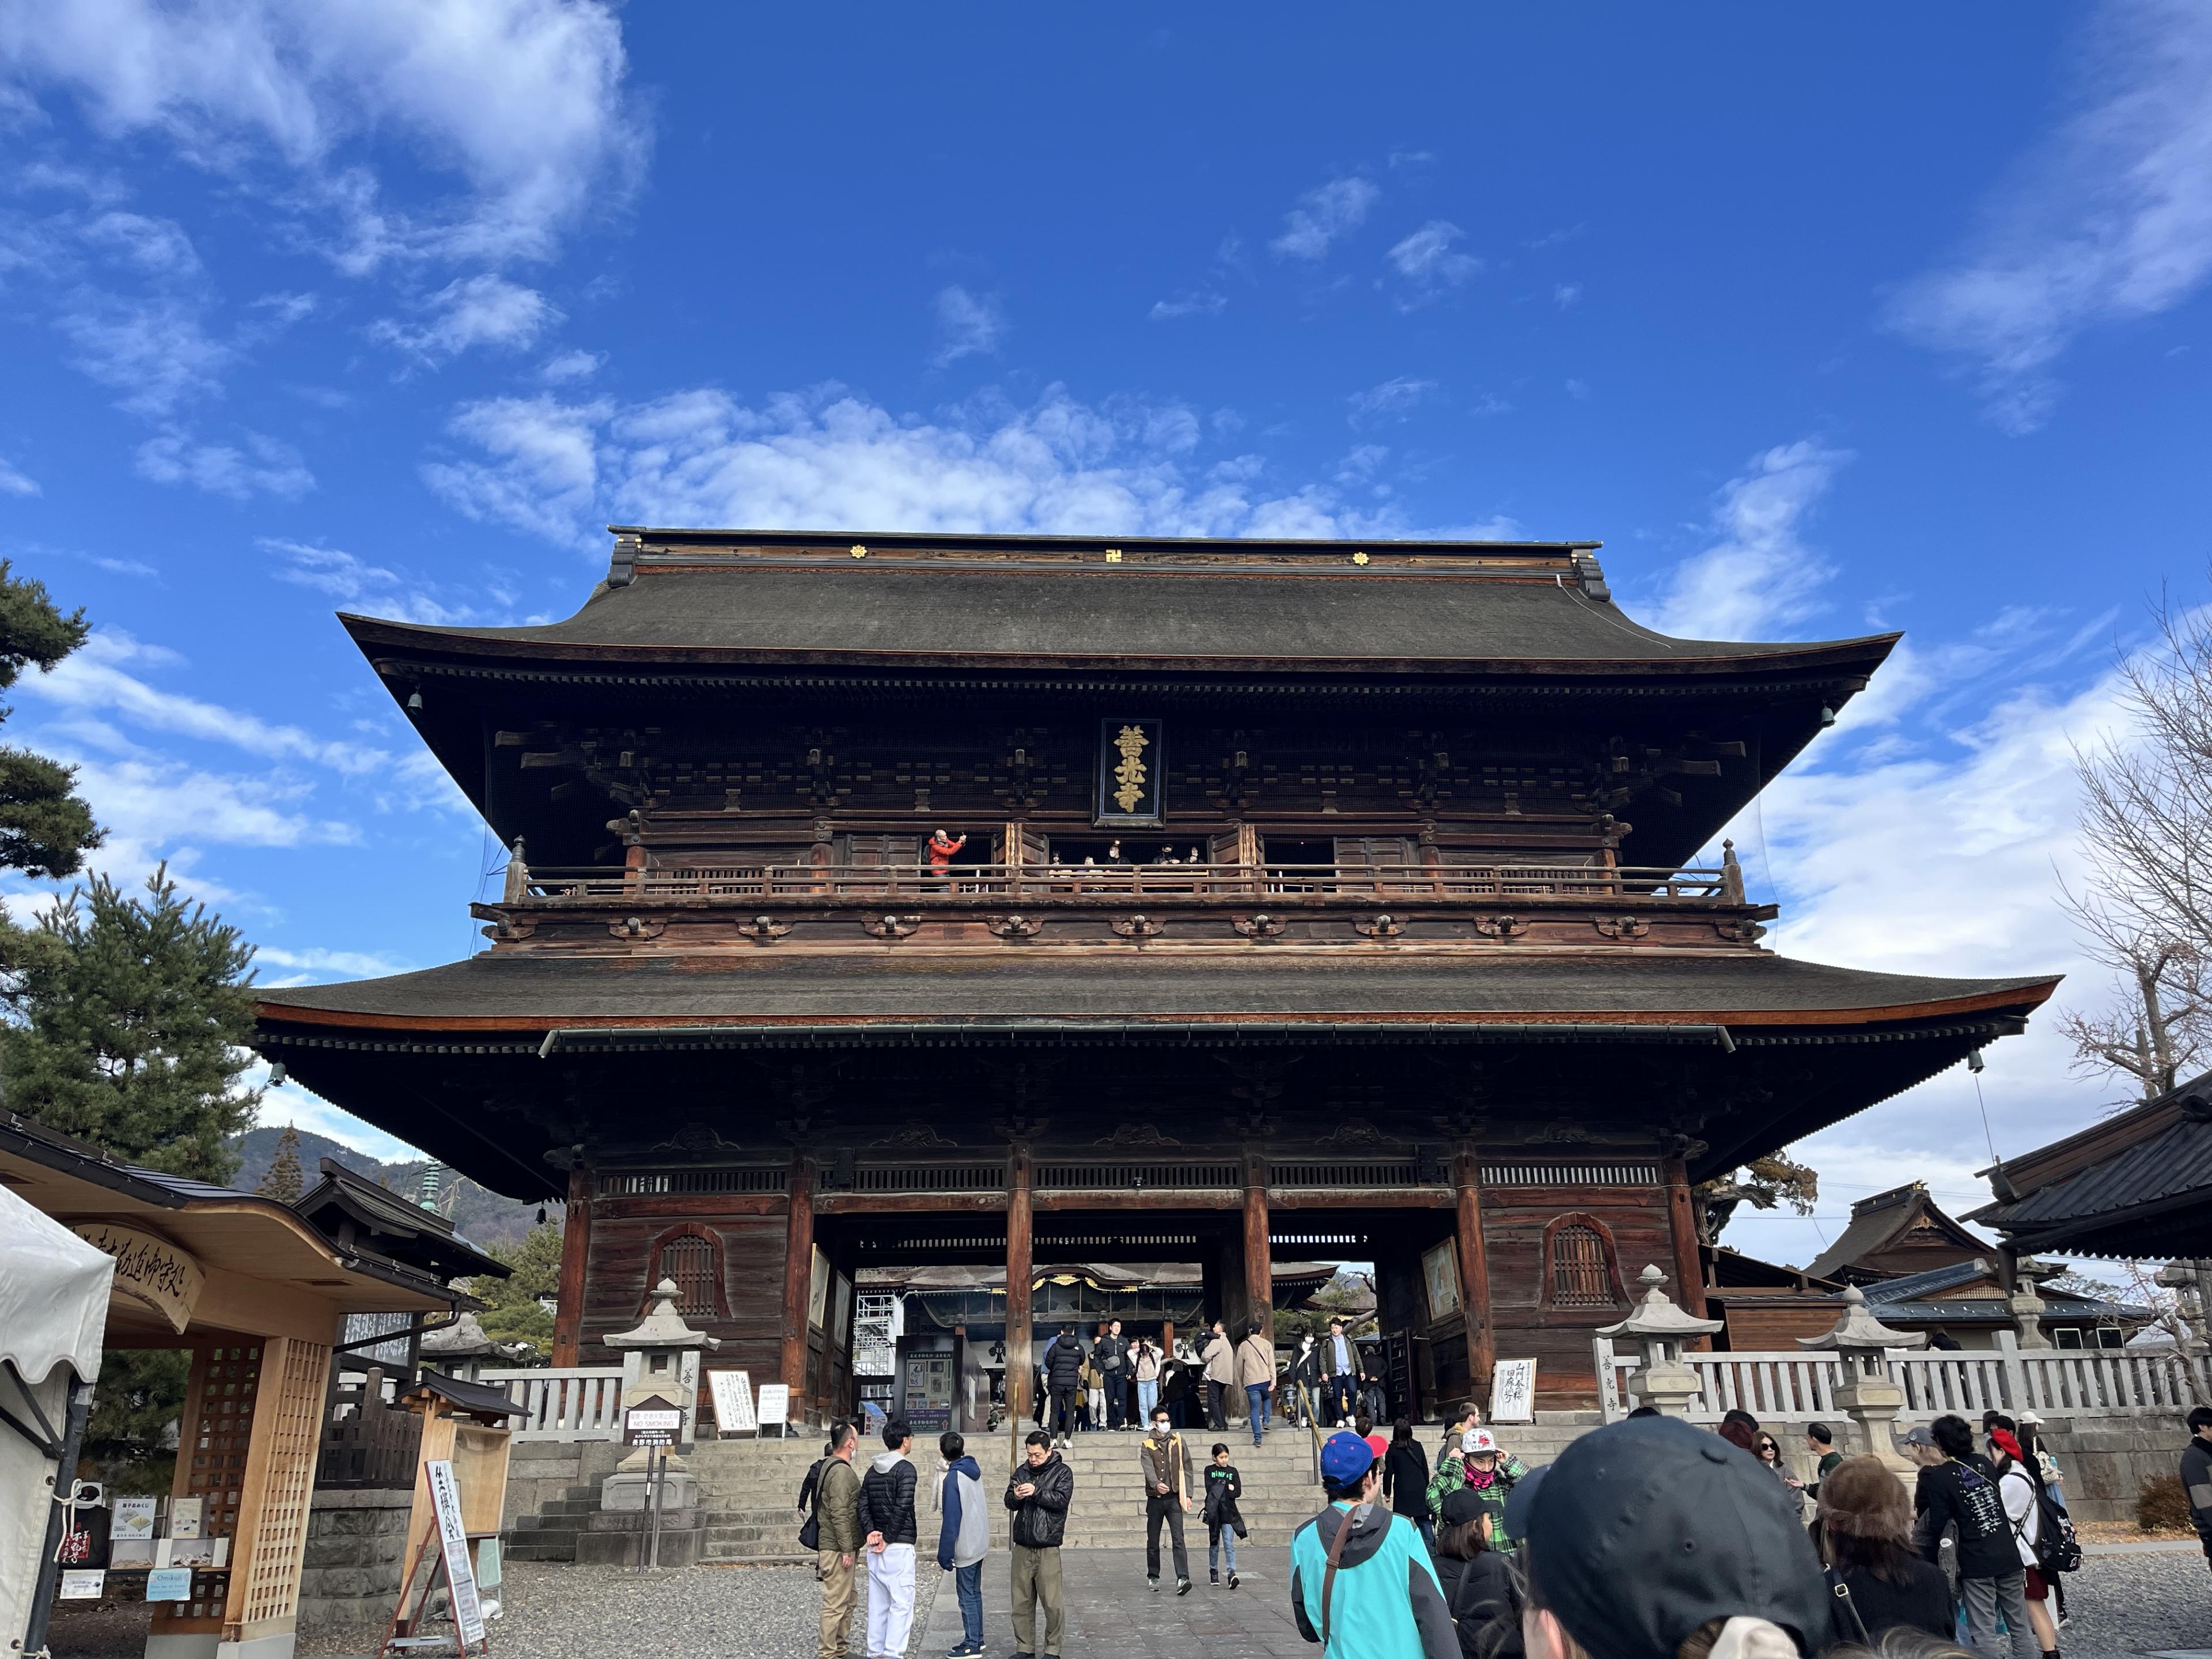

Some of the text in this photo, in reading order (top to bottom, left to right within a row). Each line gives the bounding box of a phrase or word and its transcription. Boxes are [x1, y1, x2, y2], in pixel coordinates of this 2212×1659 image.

[1113, 725, 1150, 813] 善光寺
[1602, 1355, 1618, 1411] 善光寺
